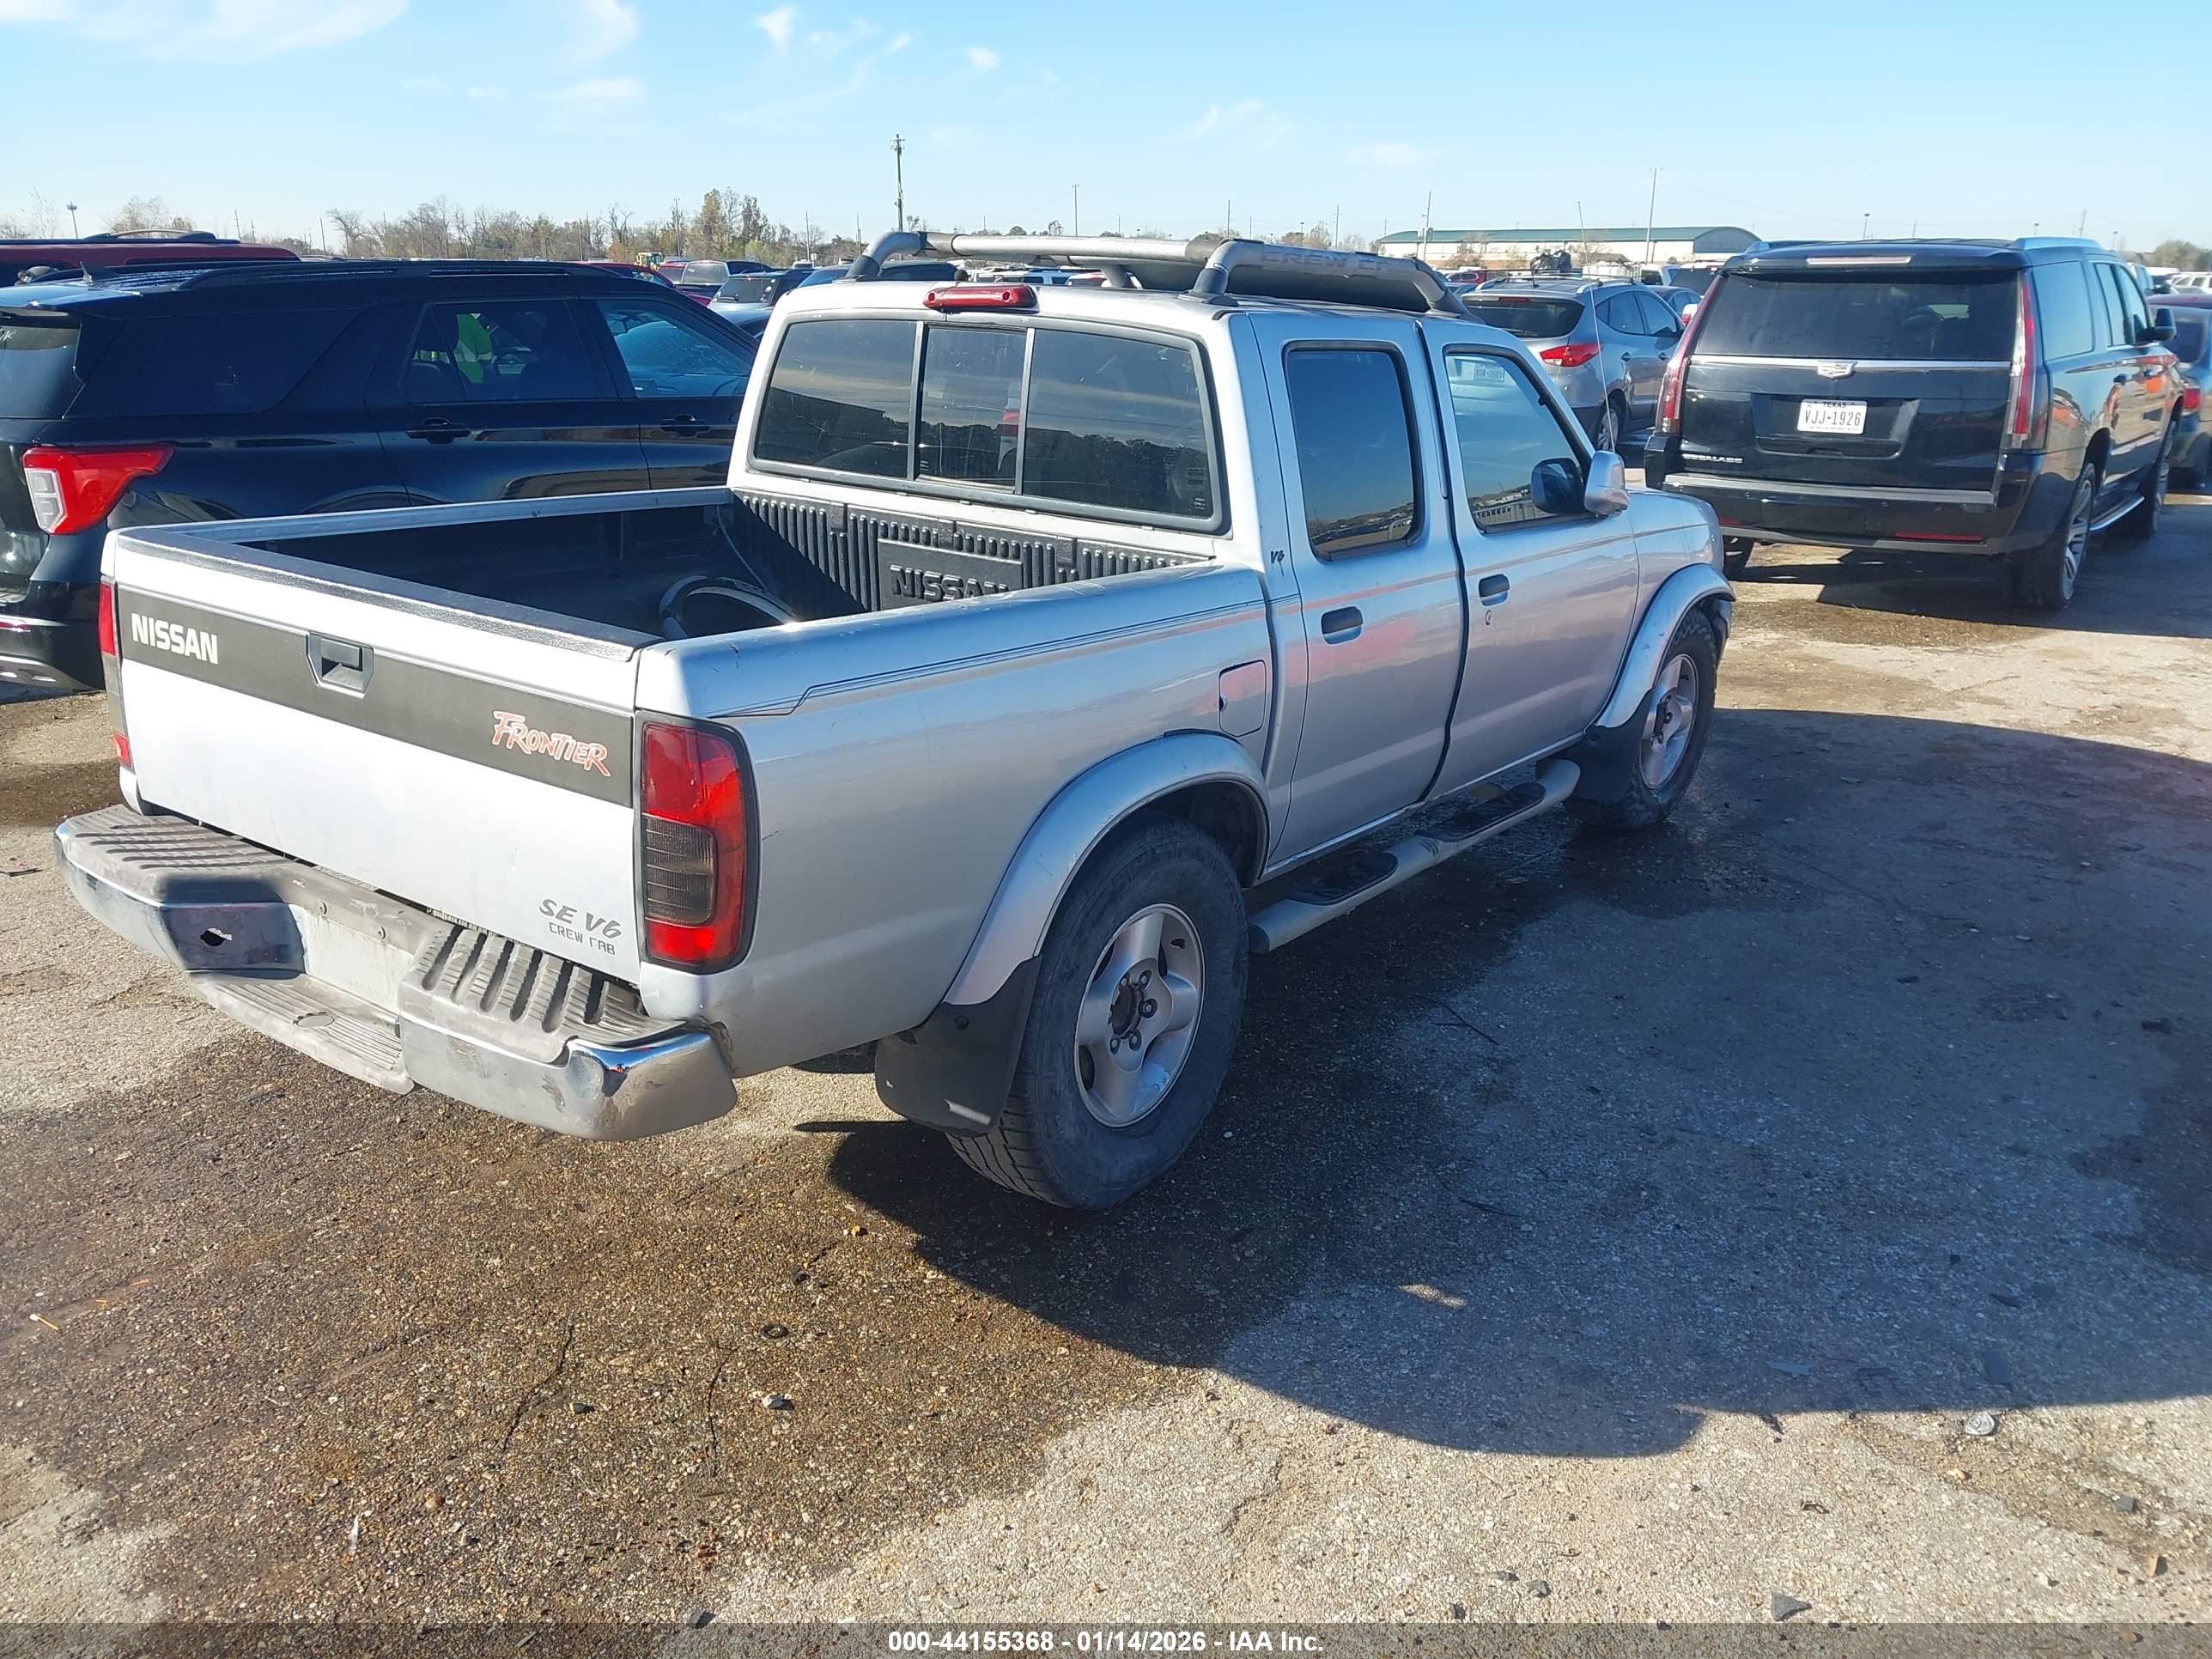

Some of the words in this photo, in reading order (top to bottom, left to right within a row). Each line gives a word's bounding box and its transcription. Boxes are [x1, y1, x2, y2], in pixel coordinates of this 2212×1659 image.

[131, 612, 218, 665] NISSAN
[492, 711, 611, 776] FRONTIER
[539, 898, 578, 924] SE
[586, 912, 622, 939] V6
[549, 921, 583, 944] CREW
